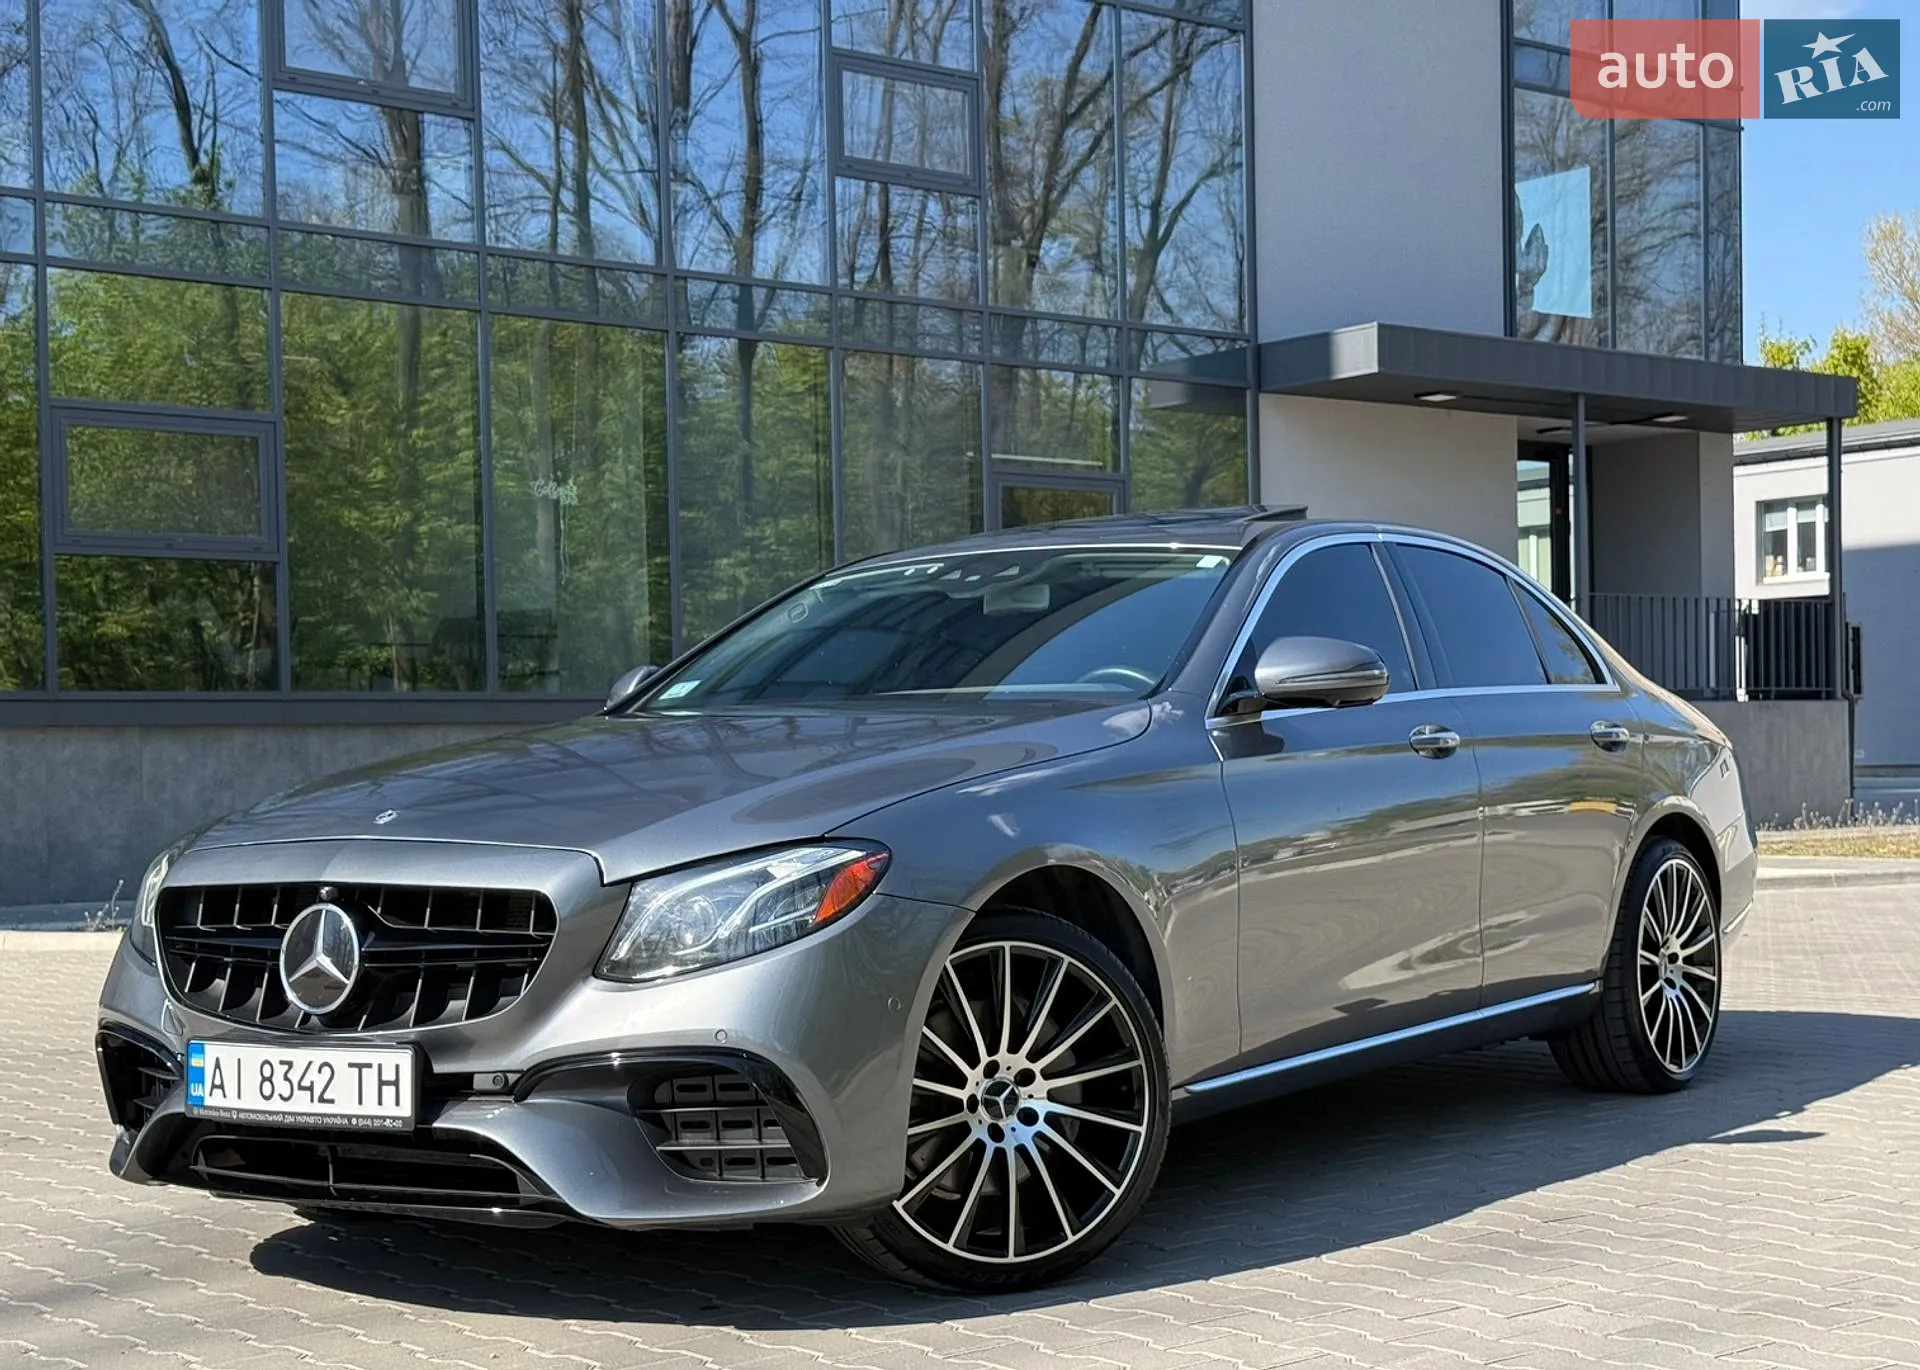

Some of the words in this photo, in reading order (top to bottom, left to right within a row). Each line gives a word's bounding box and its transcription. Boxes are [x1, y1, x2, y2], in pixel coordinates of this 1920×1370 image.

[191, 1083, 204, 1096] UA
[259, 1059, 335, 1105] 8342
[348, 1062, 401, 1107] TH
